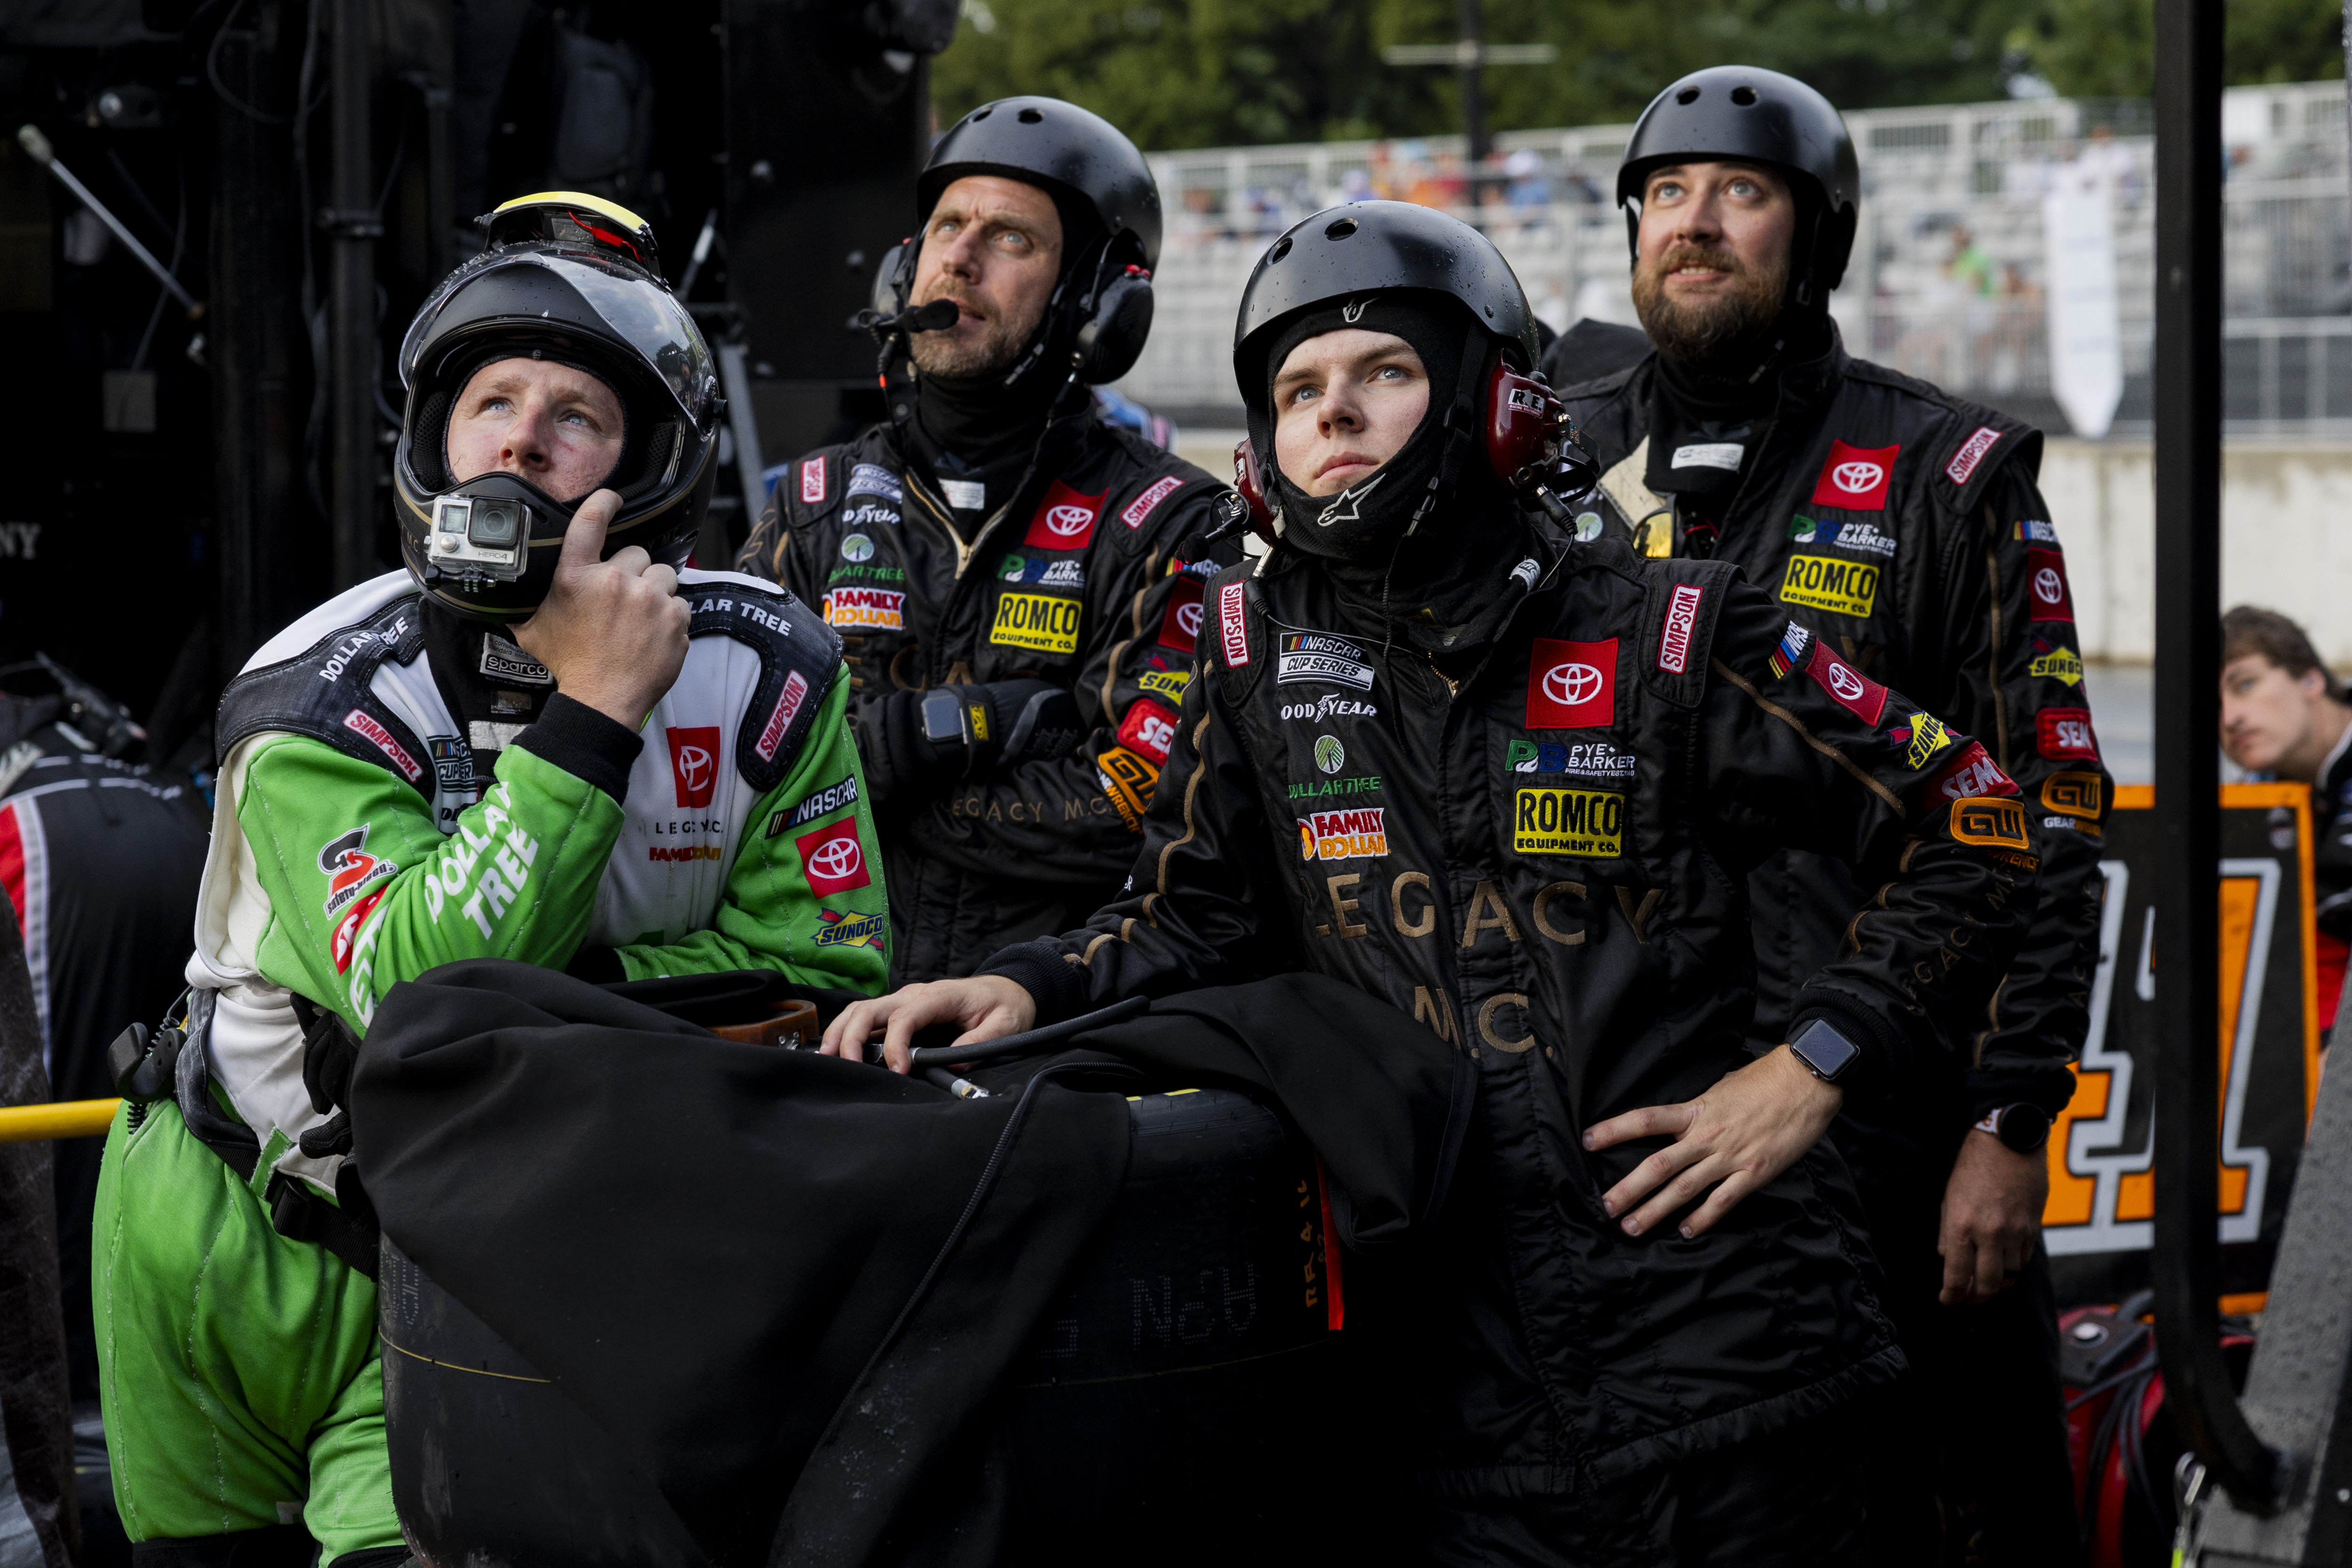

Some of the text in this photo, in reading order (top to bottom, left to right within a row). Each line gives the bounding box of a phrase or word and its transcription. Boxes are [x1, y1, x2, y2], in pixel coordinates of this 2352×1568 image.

[1952, 432, 1994, 478] SIMPSON
[1128, 480, 1174, 523] SIMPSON
[1837, 532, 1897, 550] BARKER
[478, 551, 507, 560] HERO4
[1788, 558, 1876, 600] ROMCO
[836, 591, 902, 610] FAMILY
[1784, 591, 1848, 610] EQUIPMENT
[740, 602, 792, 636] TREE
[835, 608, 900, 627] DOLLAR
[997, 597, 1079, 635] ROMCO
[1224, 587, 1245, 659] SIMPSON
[1663, 591, 1697, 667] SIMPSON
[994, 633, 1053, 647] EQUIPMENT
[1305, 636, 1361, 660] NASCAR
[318, 631, 375, 682] DOLLAR
[488, 656, 547, 675] sparco
[1287, 657, 1360, 677] CUP SERIES
[760, 677, 805, 757] SIMPSON
[350, 714, 417, 776] SIMPSON
[1571, 744, 1607, 757] PYE
[1568, 756, 1636, 769] BARKER
[1941, 756, 2004, 800] SEM
[797, 777, 858, 823] NASCAR
[1518, 792, 1622, 836] ROMCO
[1314, 811, 1383, 838] FAMILY
[1319, 834, 1385, 858] DOLLAR
[1517, 837, 1620, 853] EQUIPMENT CO.
[461, 820, 539, 940] TREE
[820, 915, 883, 943] SUNOCO
